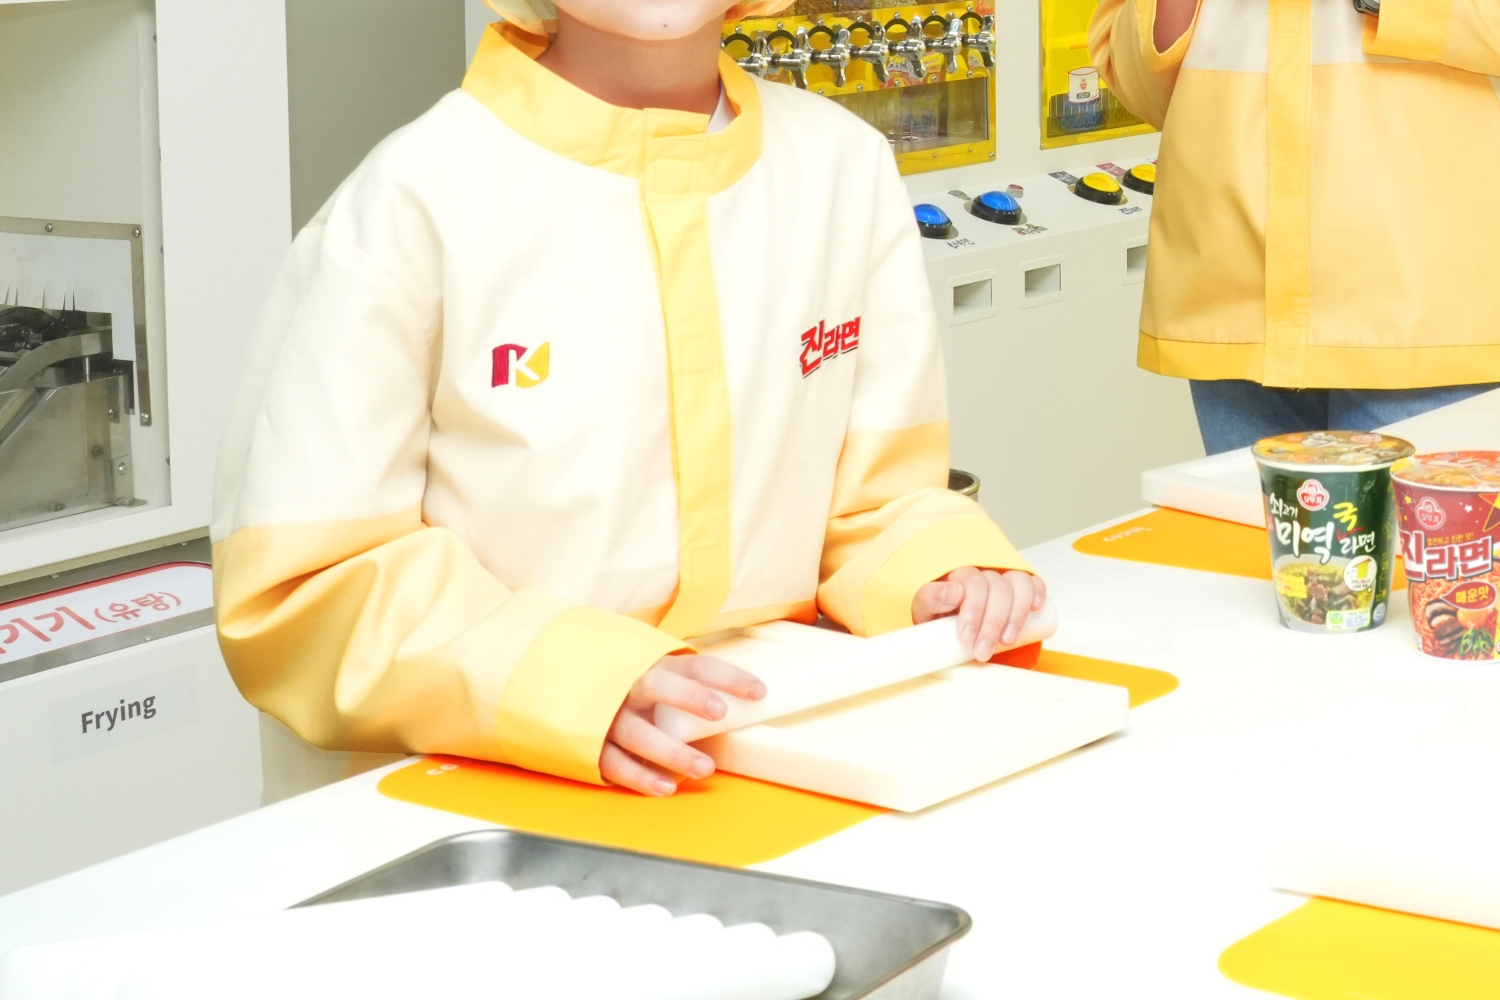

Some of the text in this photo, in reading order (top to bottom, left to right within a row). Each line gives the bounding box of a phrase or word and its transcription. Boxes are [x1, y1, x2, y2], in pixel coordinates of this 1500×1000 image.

[800, 316, 861, 378] 진라면
[1269, 492, 1298, 518] 쇠고기
[1274, 501, 1358, 565] 미역 국
[1340, 531, 1376, 555] 라면
[1400, 531, 1494, 581] 진라면
[1455, 586, 1490, 604] 매운맛
[0, 591, 182, 654] 기기(유탕)
[81, 696, 157, 734] Frying
